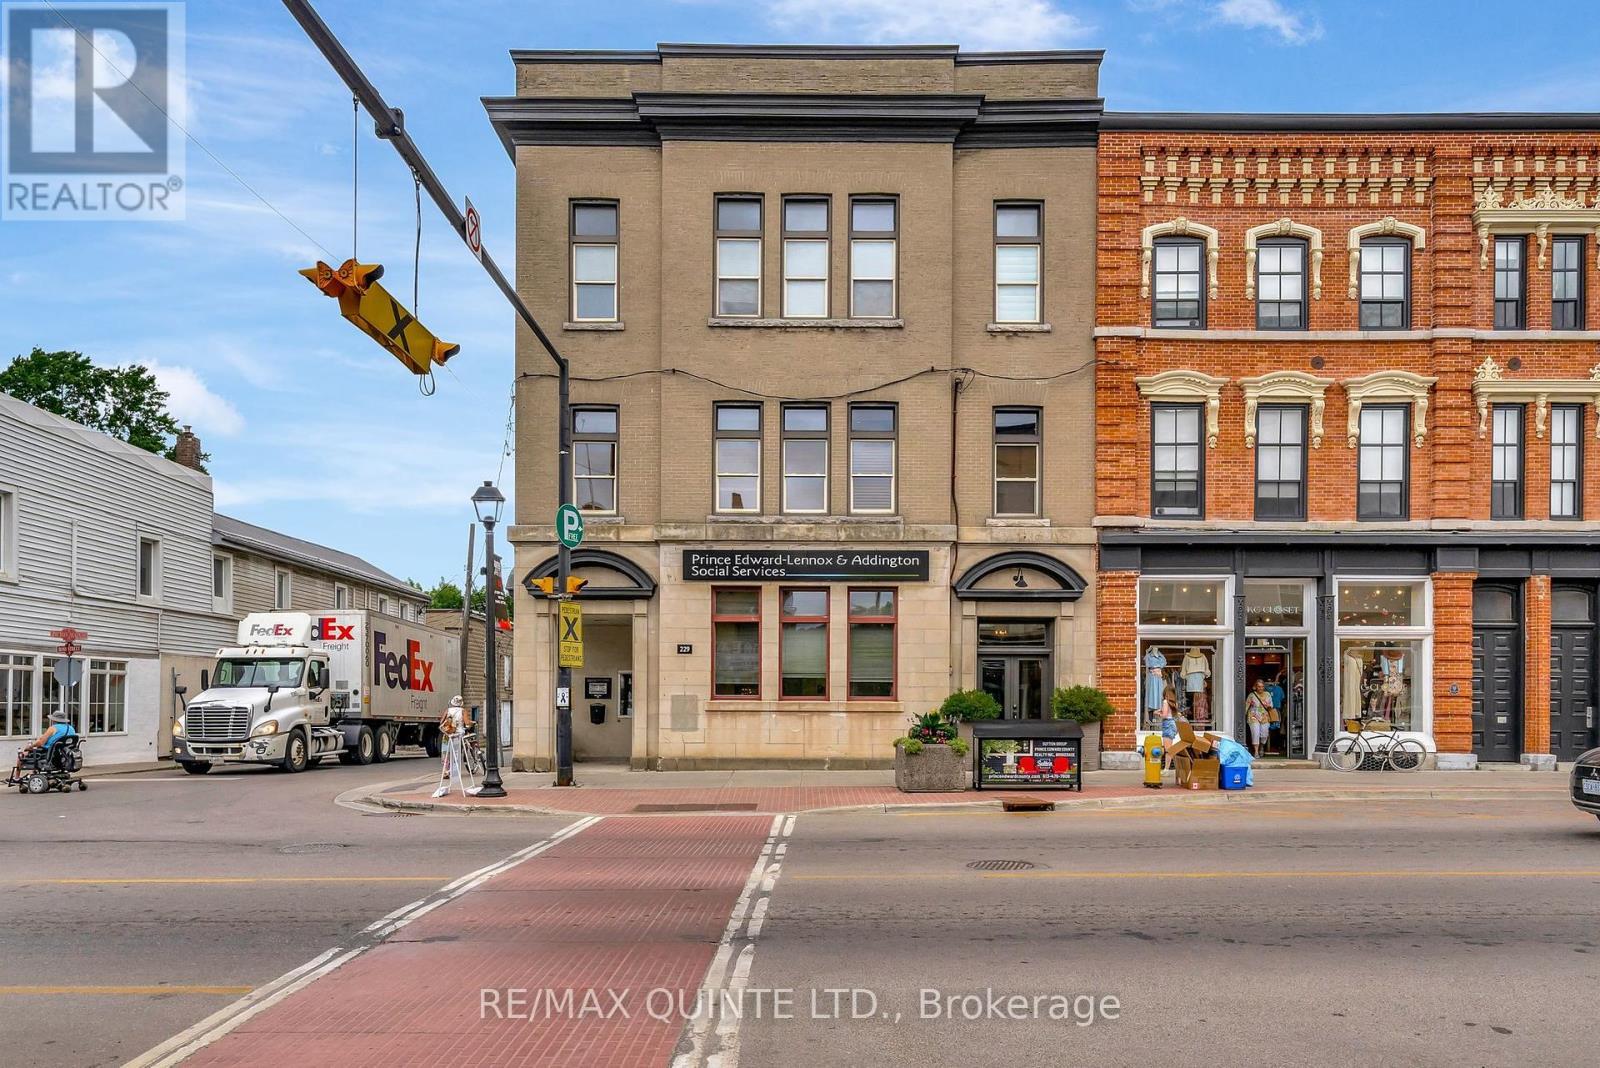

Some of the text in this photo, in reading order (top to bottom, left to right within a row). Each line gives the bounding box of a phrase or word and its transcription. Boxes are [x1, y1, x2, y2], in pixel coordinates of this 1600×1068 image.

[563, 509, 579, 540] P
[692, 554, 920, 567] Prince Edward-Lennox & Addington
[691, 565, 786, 577] Social Services
[250, 623, 294, 637] FedEx
[563, 616, 579, 641] X
[322, 642, 350, 651] Freight
[374, 630, 434, 693] FedEx
